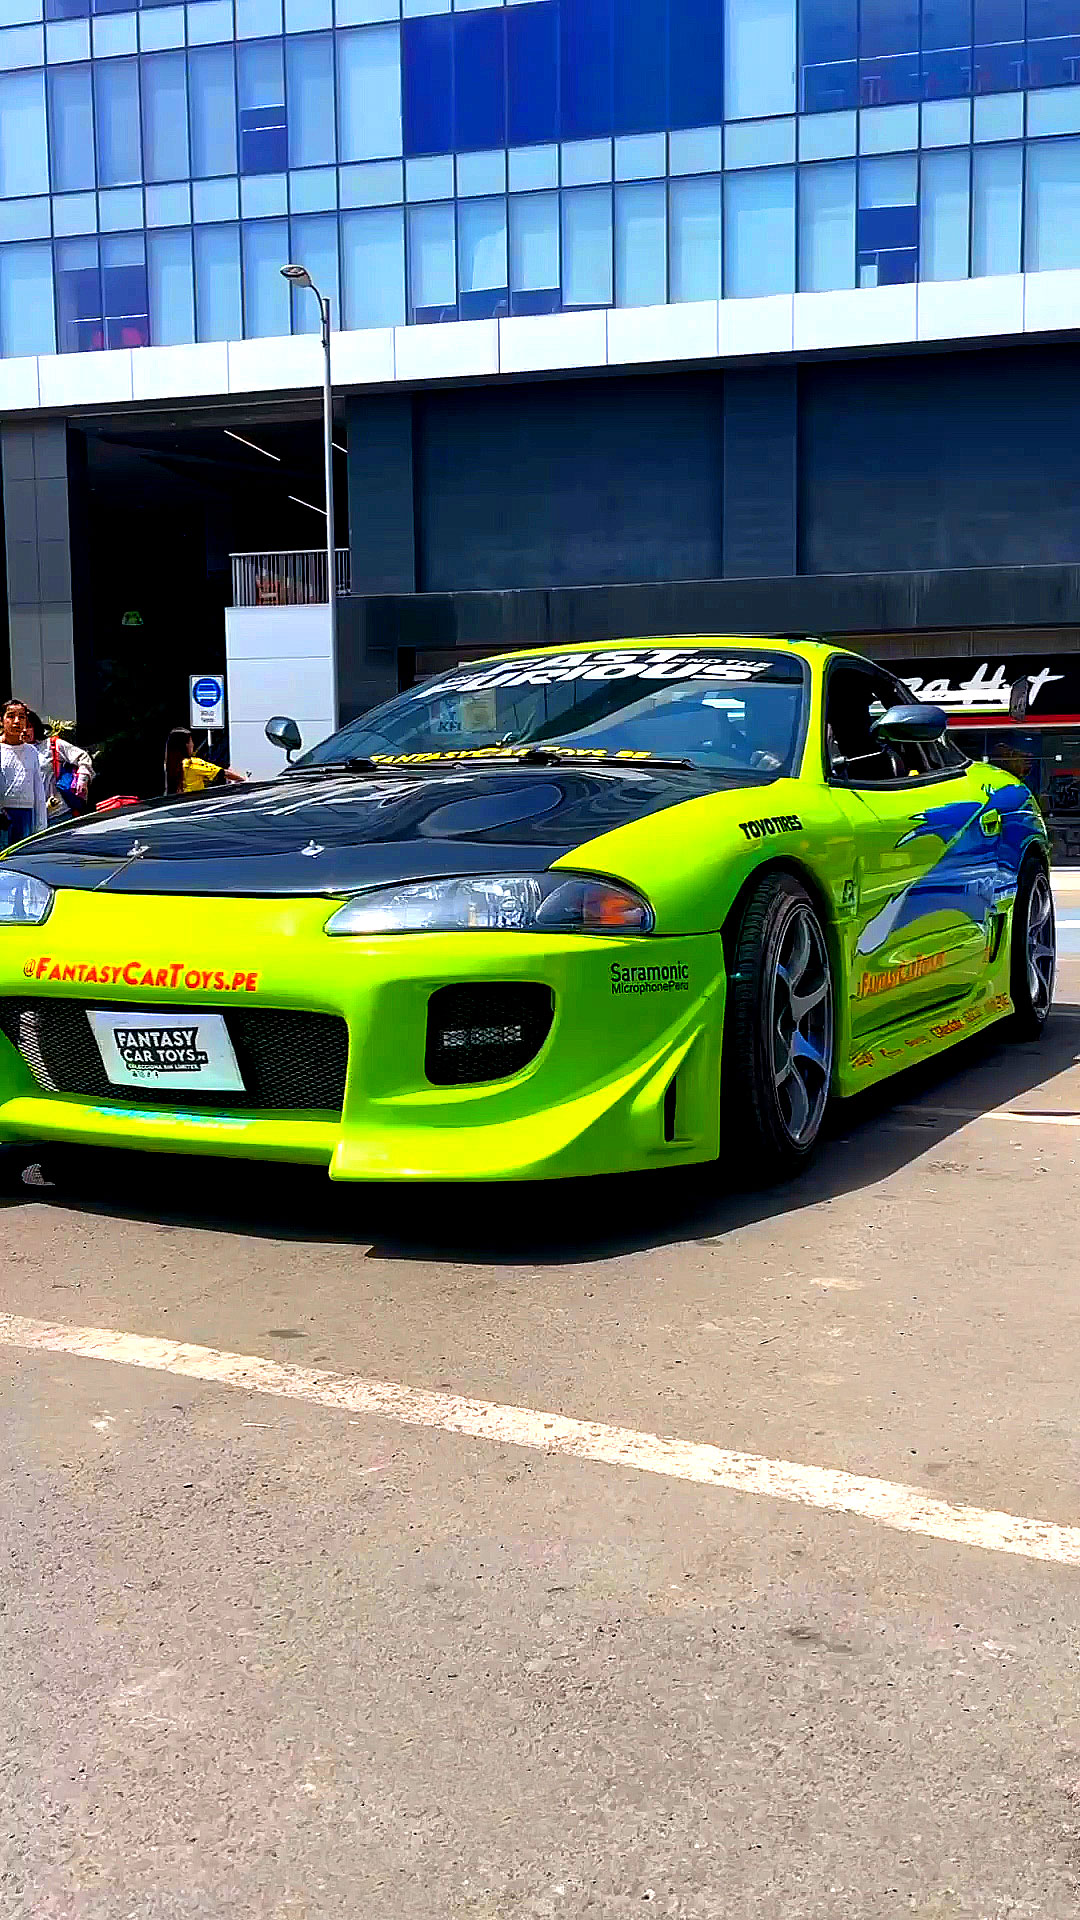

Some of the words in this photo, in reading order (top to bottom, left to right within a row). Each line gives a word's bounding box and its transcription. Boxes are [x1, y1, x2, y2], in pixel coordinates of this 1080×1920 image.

[486, 649, 704, 676] FAST
[411, 663, 768, 701] FURIOUS
[958, 662, 1066, 706] Ht
[610, 961, 689, 982] Saramonic
[116, 1030, 194, 1047] FANTASY
[123, 1049, 153, 1062] CAR
